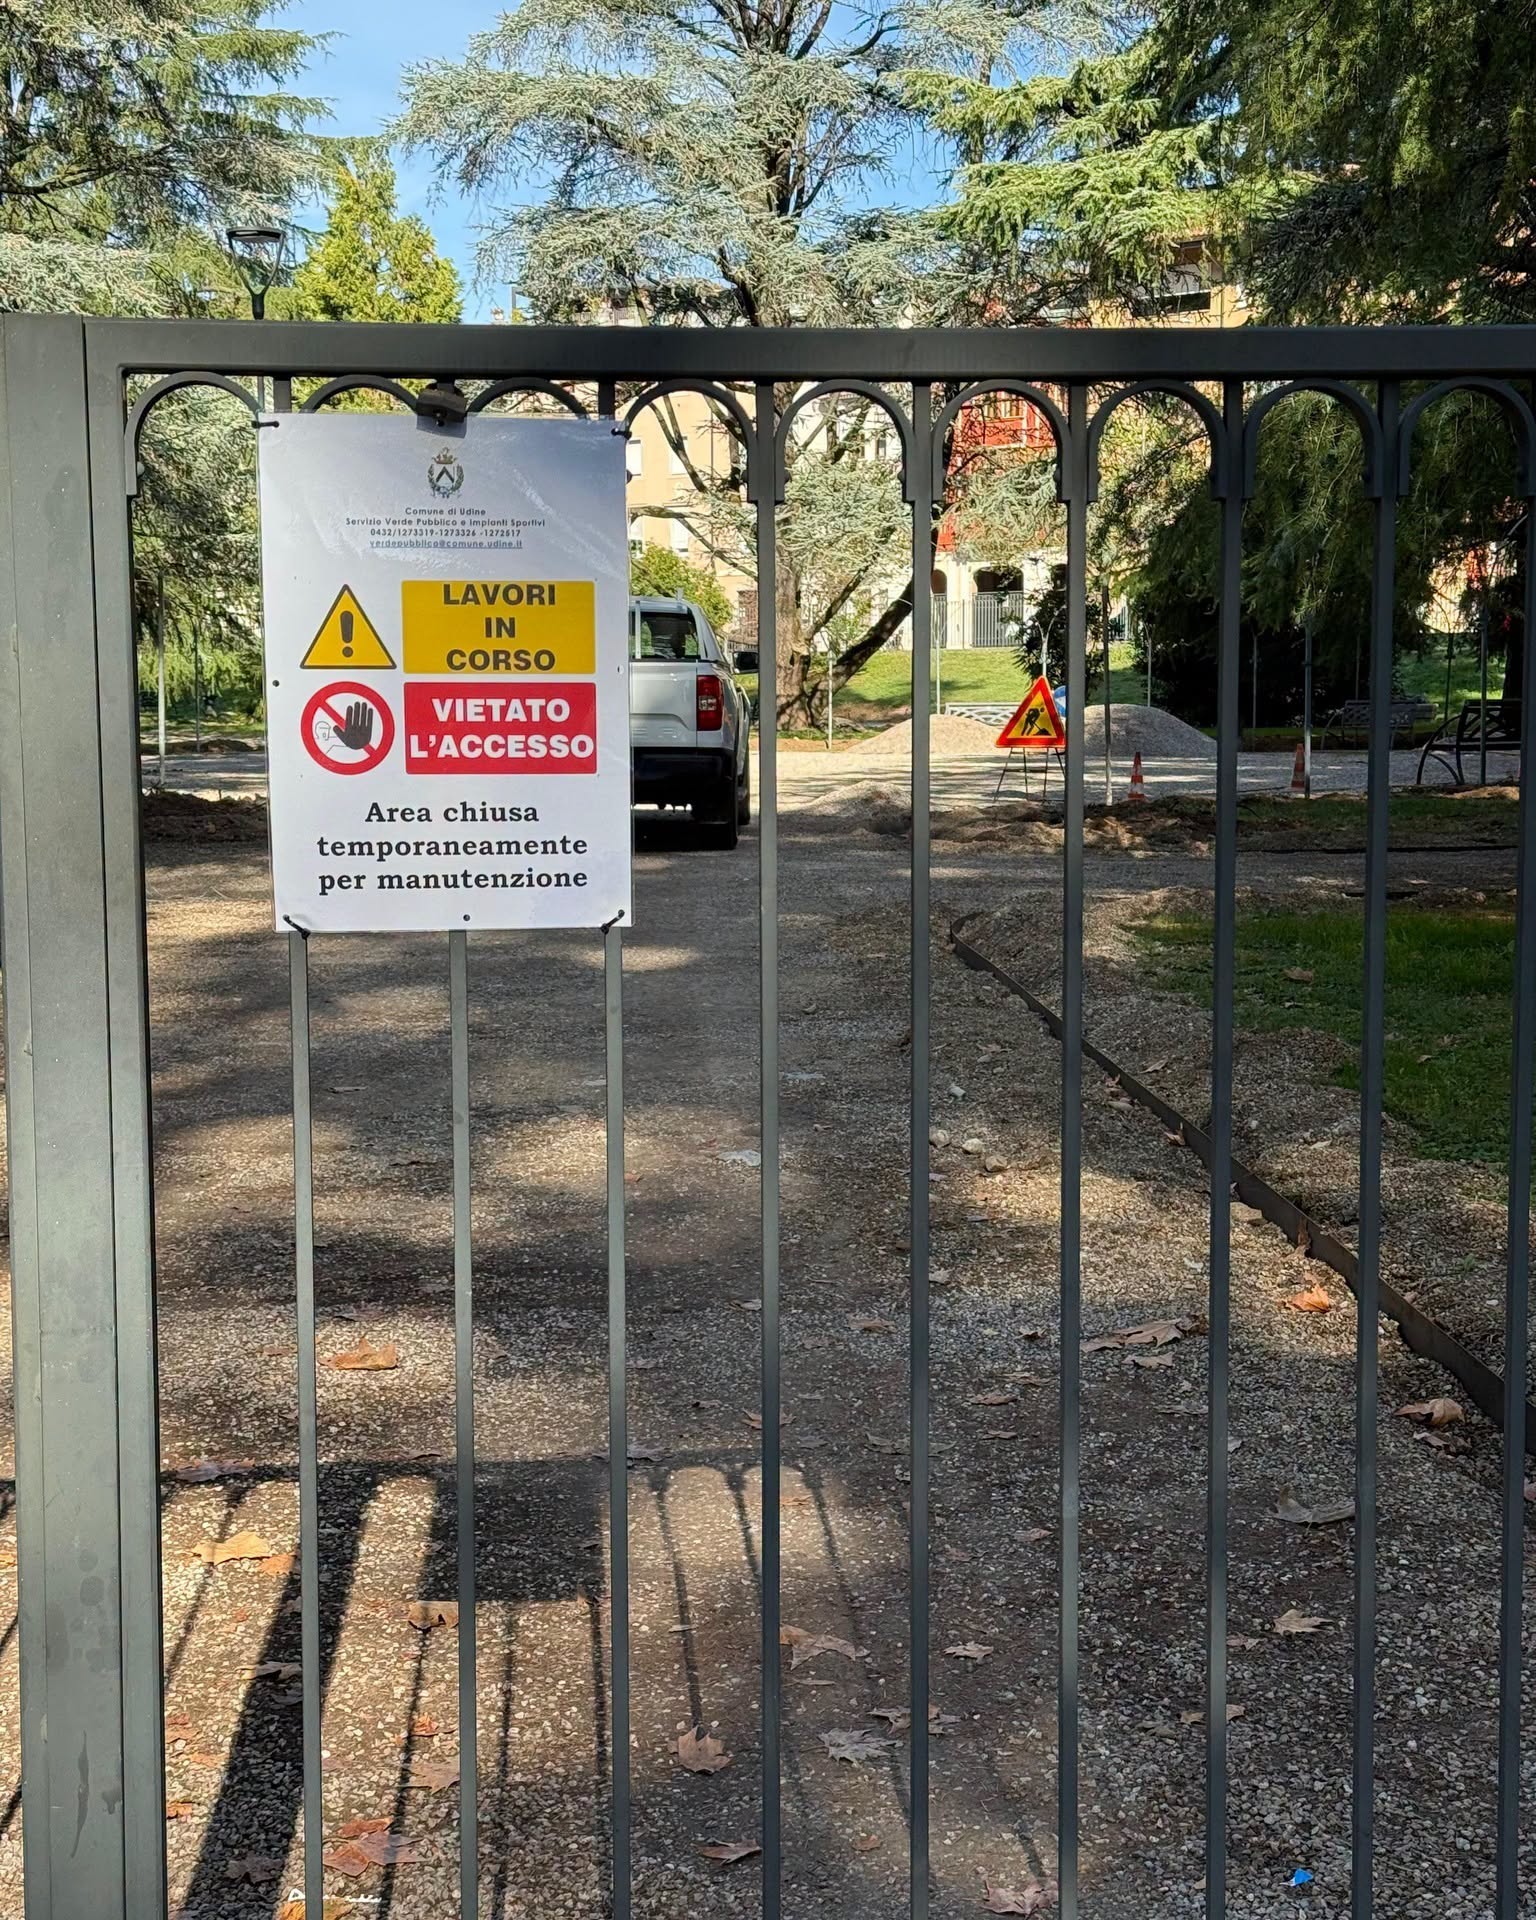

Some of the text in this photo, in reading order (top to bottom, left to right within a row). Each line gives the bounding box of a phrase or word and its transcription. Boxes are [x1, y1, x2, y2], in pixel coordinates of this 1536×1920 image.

[405, 507, 486, 516] Comune di Udine
[345, 518, 382, 526] Servizio
[385, 518, 413, 526] Verde
[416, 518, 457, 527] Pubblico
[510, 519, 545, 528] Sportivi
[369, 540, 522, 549] verdepubblico@comune.udine.it
[443, 584, 556, 606] LAVORI
[485, 617, 516, 638] IN
[446, 649, 556, 671] CORSO
[431, 698, 570, 722] VIETATO
[410, 734, 594, 758] L'ACCESSO
[365, 801, 539, 822] Area chiusa
[317, 835, 588, 862] temporaneamente
[318, 867, 588, 895] per manutenzione
